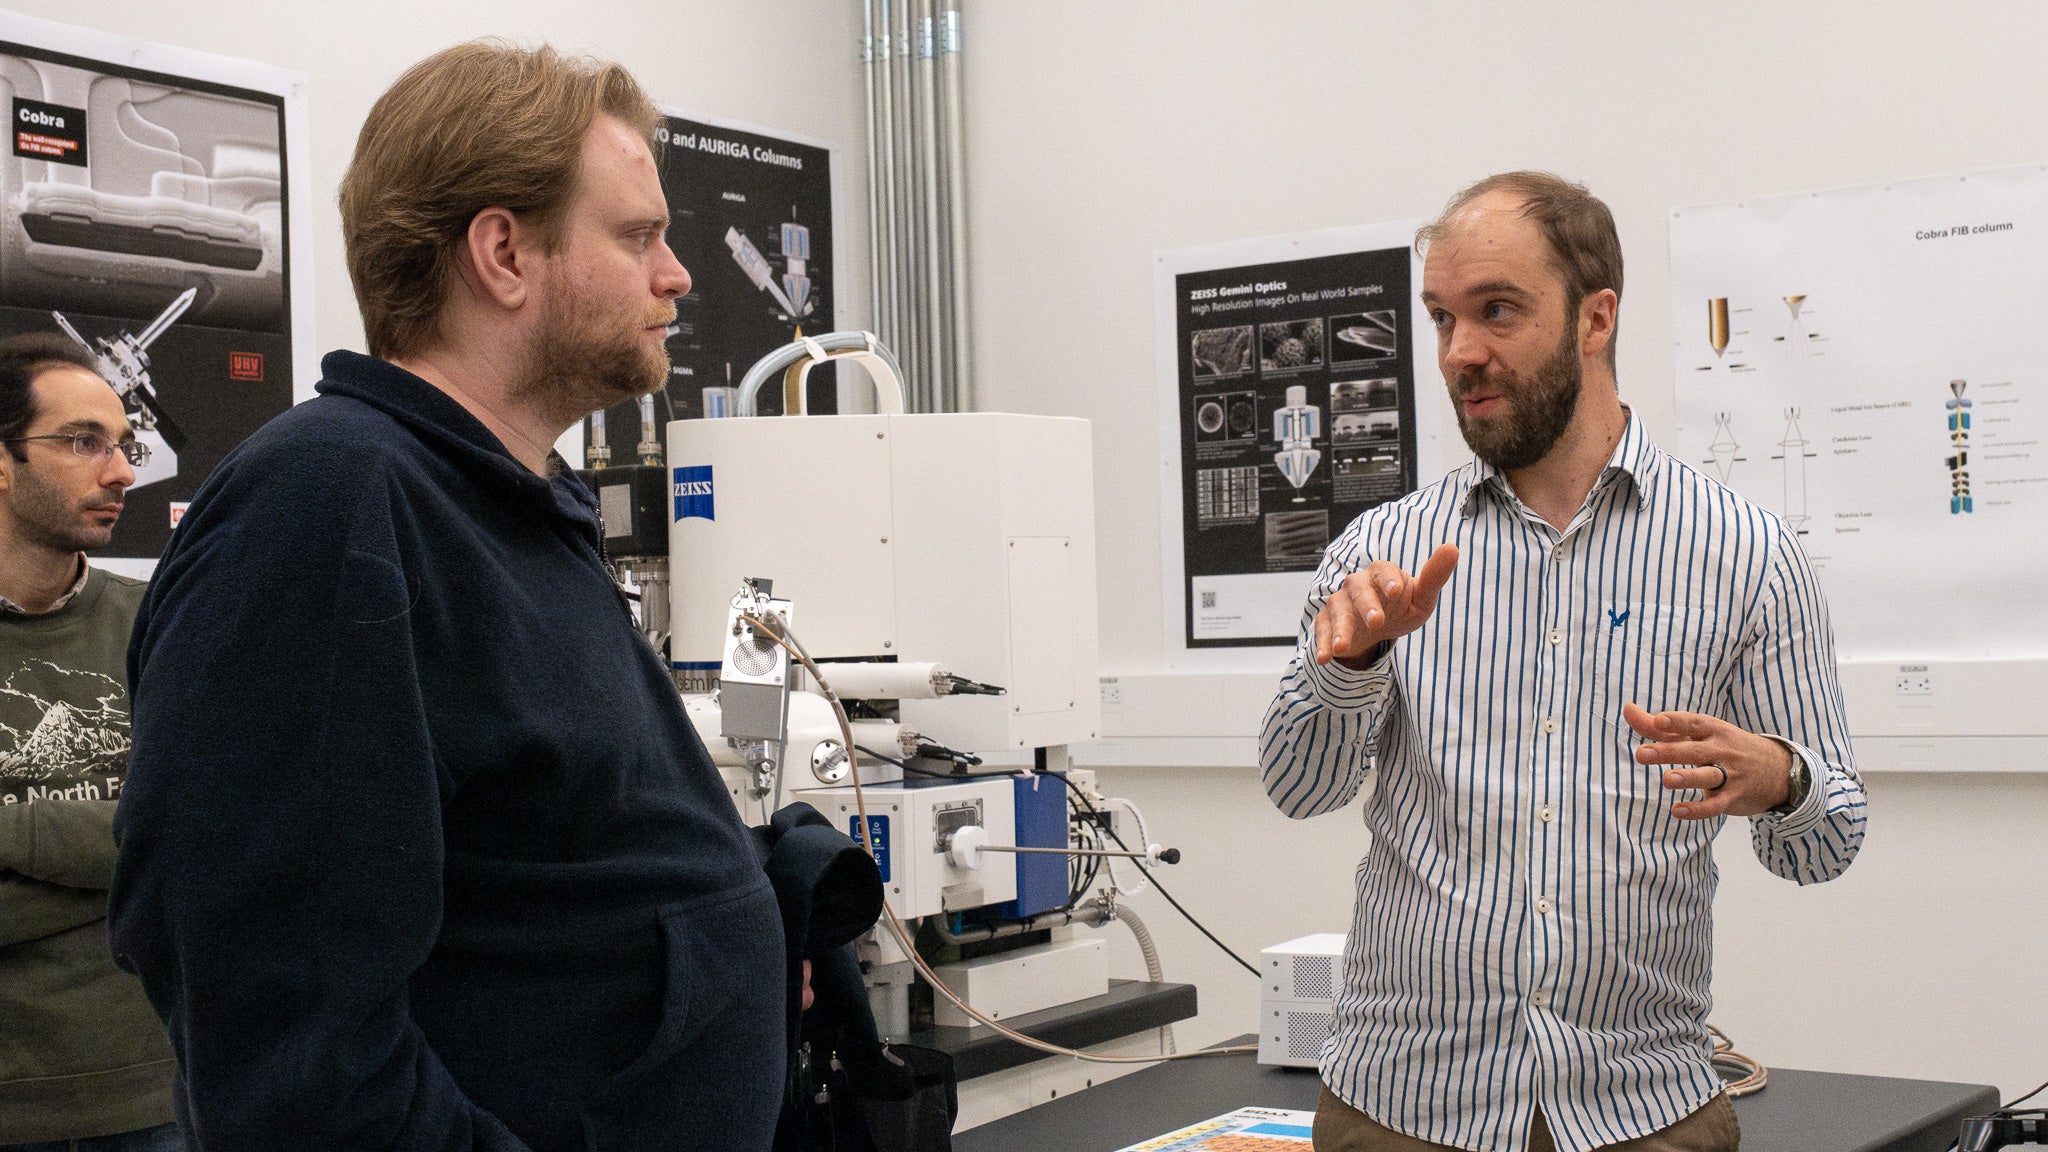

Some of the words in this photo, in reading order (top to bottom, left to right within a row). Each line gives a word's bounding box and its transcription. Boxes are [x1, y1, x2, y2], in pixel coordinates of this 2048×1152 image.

[19, 108, 65, 128] Cobra
[672, 132, 696, 149] and
[698, 136, 751, 159] AURIGA
[752, 146, 803, 170] Columns
[721, 191, 746, 202] AURIGA
[1915, 230, 1949, 241] Cobra
[1951, 225, 1969, 237] FIB
[1972, 222, 2013, 234] column
[1190, 288, 1218, 300] ZEISS
[1219, 284, 1253, 297] Gemini
[1254, 281, 1288, 294] Optics
[1191, 304, 1211, 316] High
[1211, 299, 1254, 313] Resolution
[1255, 295, 1286, 308] Images
[1286, 294, 1300, 304] On
[1301, 291, 1319, 302] Real
[1320, 287, 1346, 300] World
[1347, 284, 1384, 298] Samples
[674, 481, 712, 496] ZEISS
[27, 780, 100, 806] North
